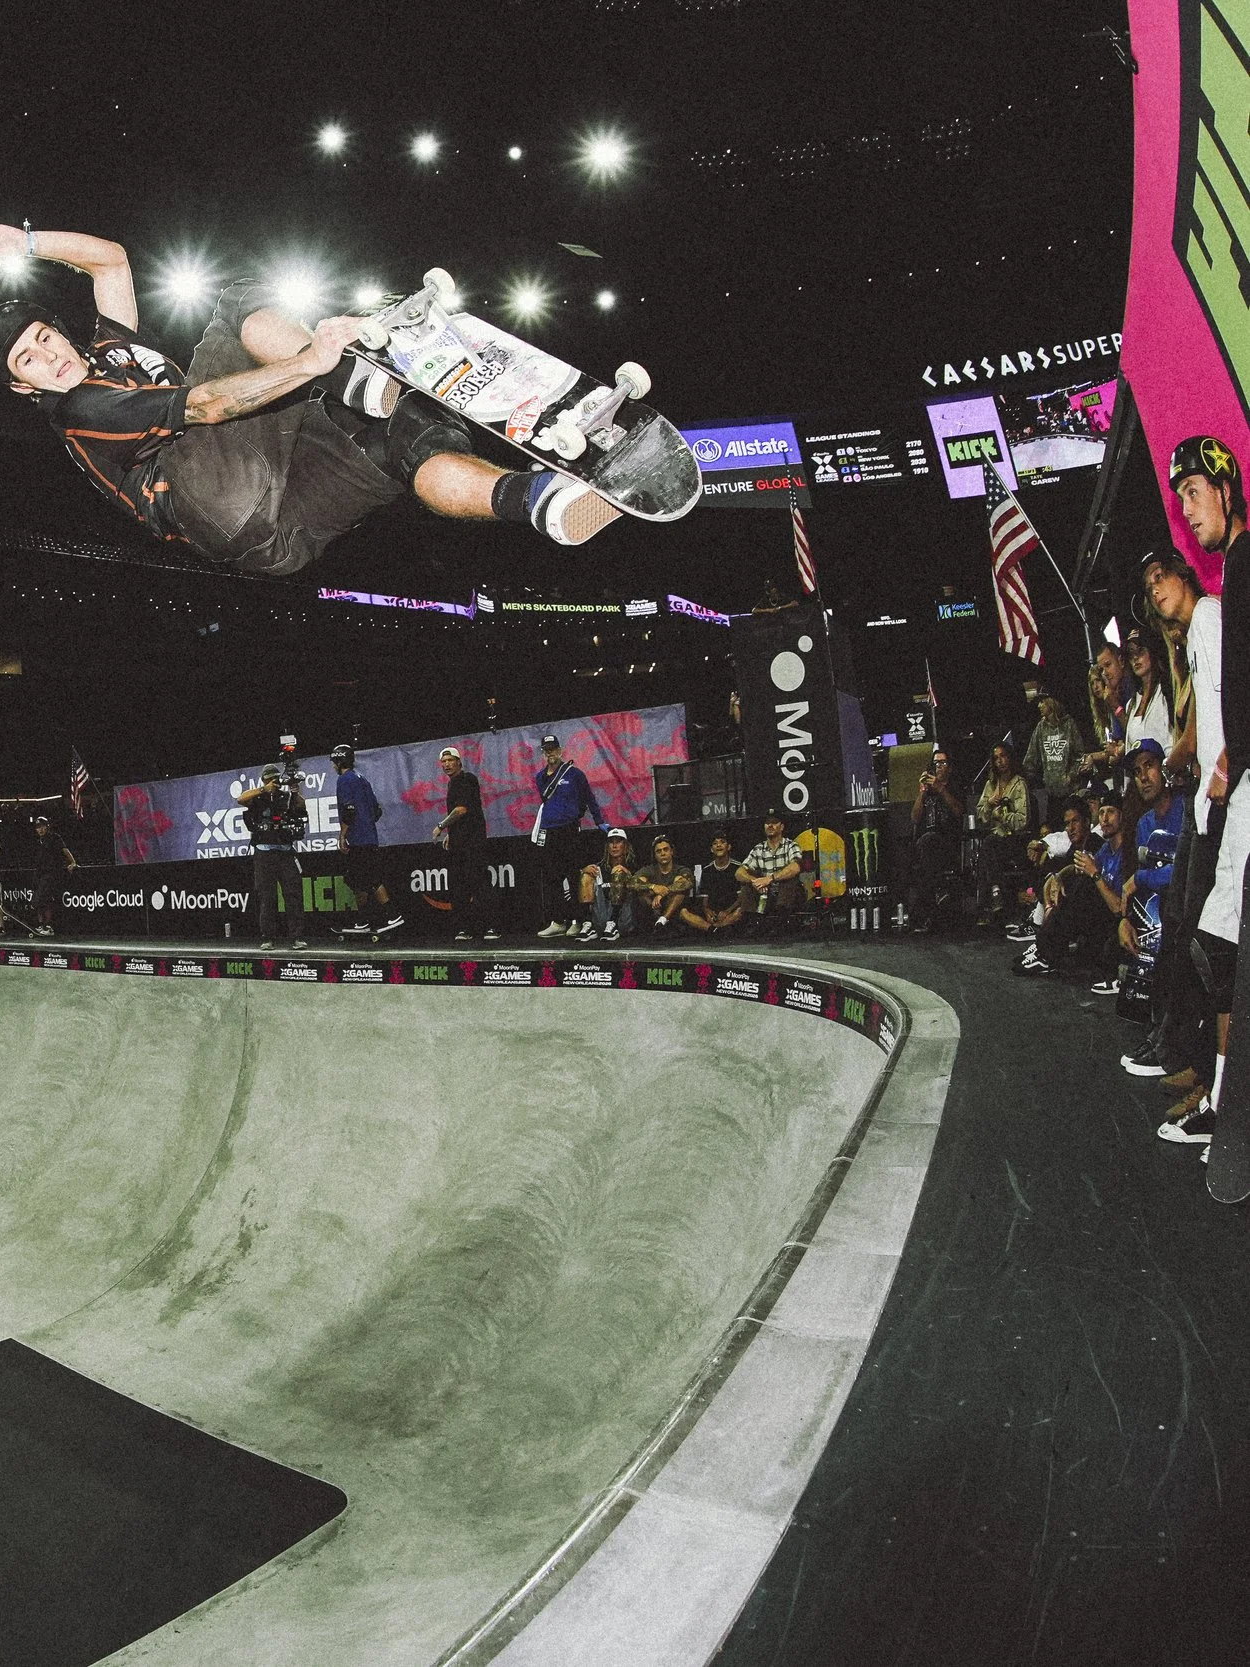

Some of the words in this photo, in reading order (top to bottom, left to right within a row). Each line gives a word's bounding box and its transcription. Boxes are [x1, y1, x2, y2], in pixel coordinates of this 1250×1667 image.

[921, 347, 1051, 387] CAESARS
[445, 361, 505, 410] BONES
[805, 434, 837, 443] LEAGUE
[947, 437, 998, 462] KICK
[704, 481, 754, 495] ENTURE
[502, 602, 532, 611] MEN'S
[533, 603, 594, 612] SKATEBOARD
[596, 604, 621, 613] PARK
[952, 609, 976, 618] Federal
[196, 846, 234, 859] NEW
[410, 863, 515, 893] amon
[62, 890, 104, 912] Google
[106, 889, 144, 907] Cloud
[277, 876, 359, 912] ICK
[170, 889, 250, 913] MoonPay
[85, 957, 106, 969] KICK
[125, 962, 154, 971] XGAMES
[172, 964, 203, 973] XGAMES
[227, 962, 253, 975] KICK
[280, 968, 318, 977] XGAMES
[342, 969, 383, 978] XGAMES
[414, 966, 449, 980] KICK
[483, 971, 532, 980] XGAMES
[563, 971, 612, 982] XGAMES
[647, 967, 683, 986] KICK
[731, 971, 750, 981] MoonPay
[716, 978, 760, 993] XGAMES
[785, 988, 822, 1007] XGAMES
